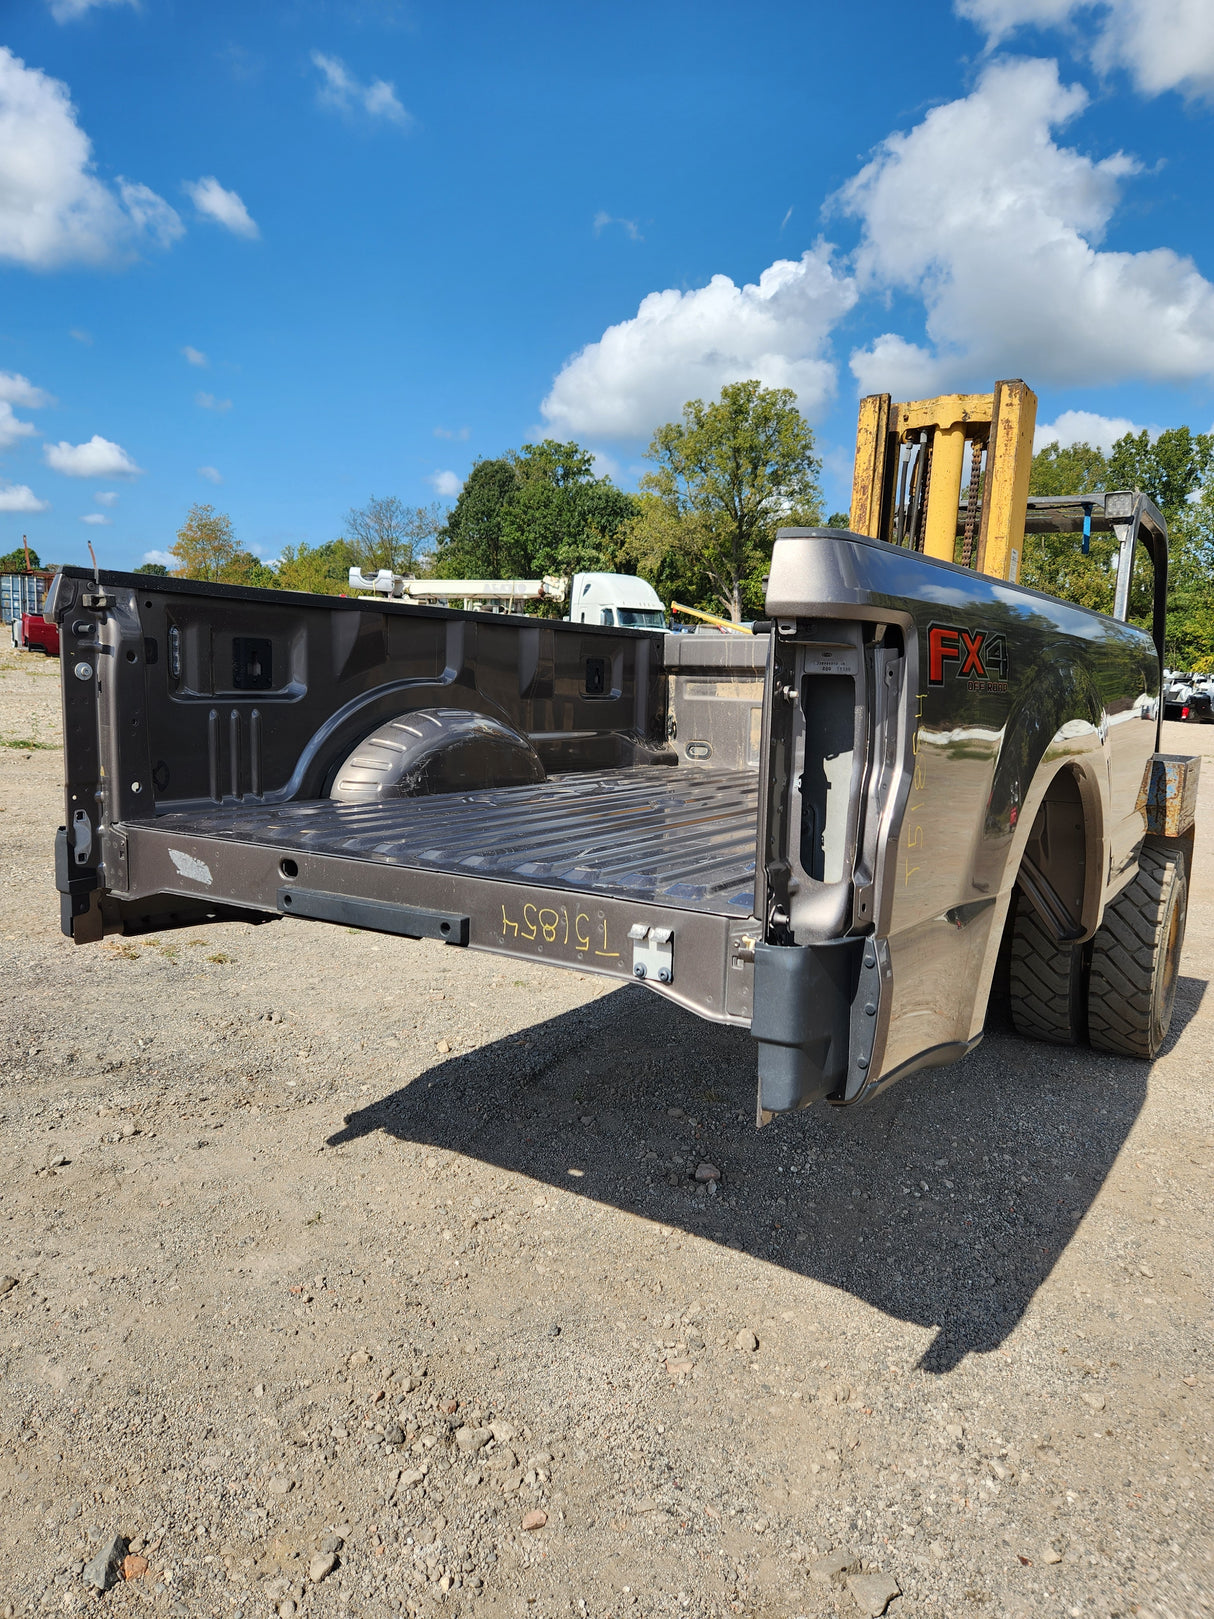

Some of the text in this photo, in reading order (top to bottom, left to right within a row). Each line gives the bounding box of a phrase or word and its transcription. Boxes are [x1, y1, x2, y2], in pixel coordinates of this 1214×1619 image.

[927, 620, 1009, 687] FX4
[967, 681, 1008, 693] OFF ROAD
[502, 903, 620, 957] T51854
